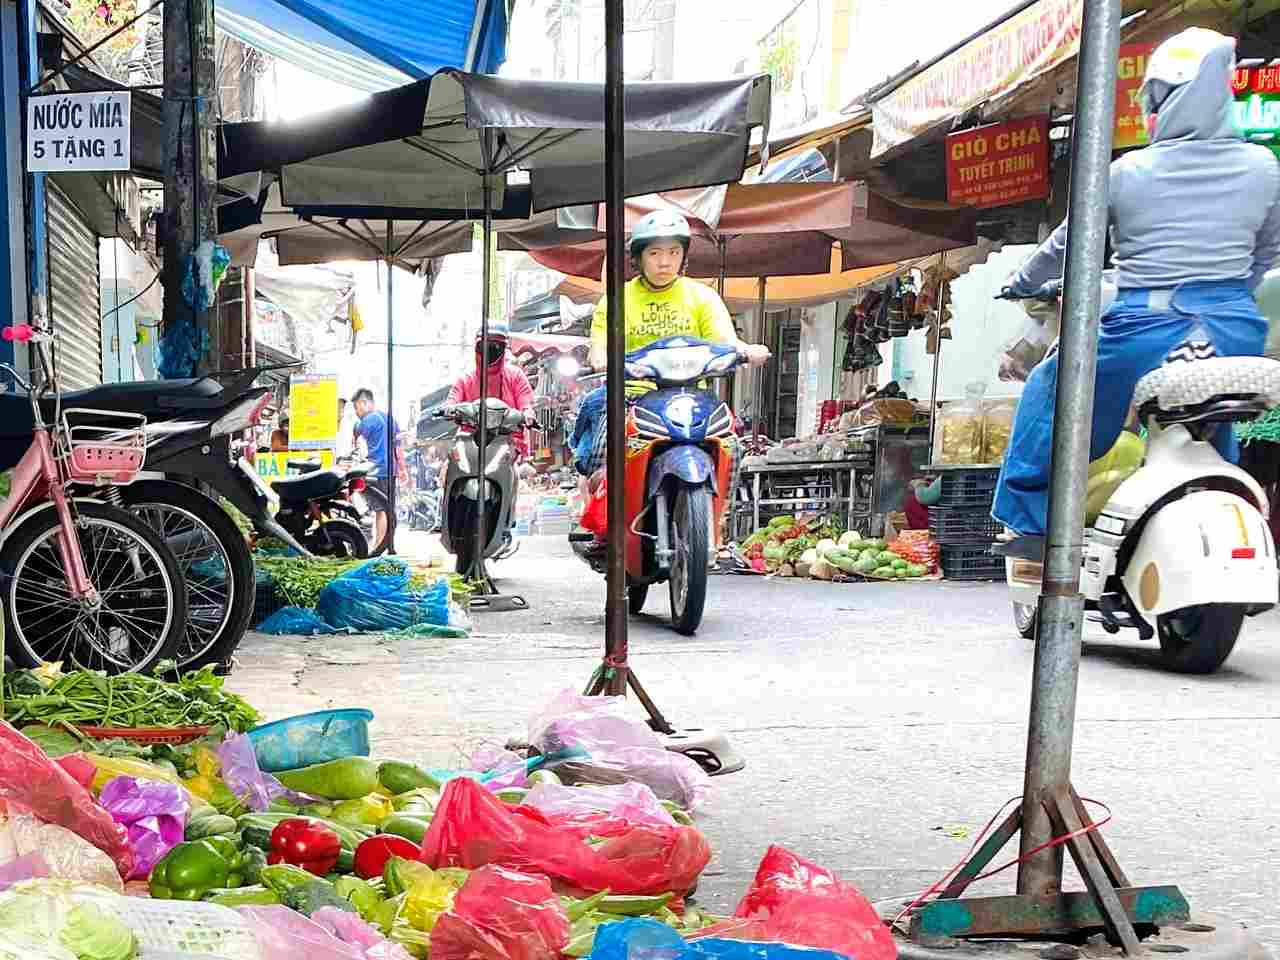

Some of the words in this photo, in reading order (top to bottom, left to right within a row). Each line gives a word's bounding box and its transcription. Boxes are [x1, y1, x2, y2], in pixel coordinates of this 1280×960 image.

[33, 98, 82, 130] NƯỚC
[89, 96, 123, 128] MÍA
[33, 140, 46, 158] 5
[52, 136, 105, 164] TẶNG
[113, 139, 124, 157] 1
[951, 135, 988, 161] GIÒ
